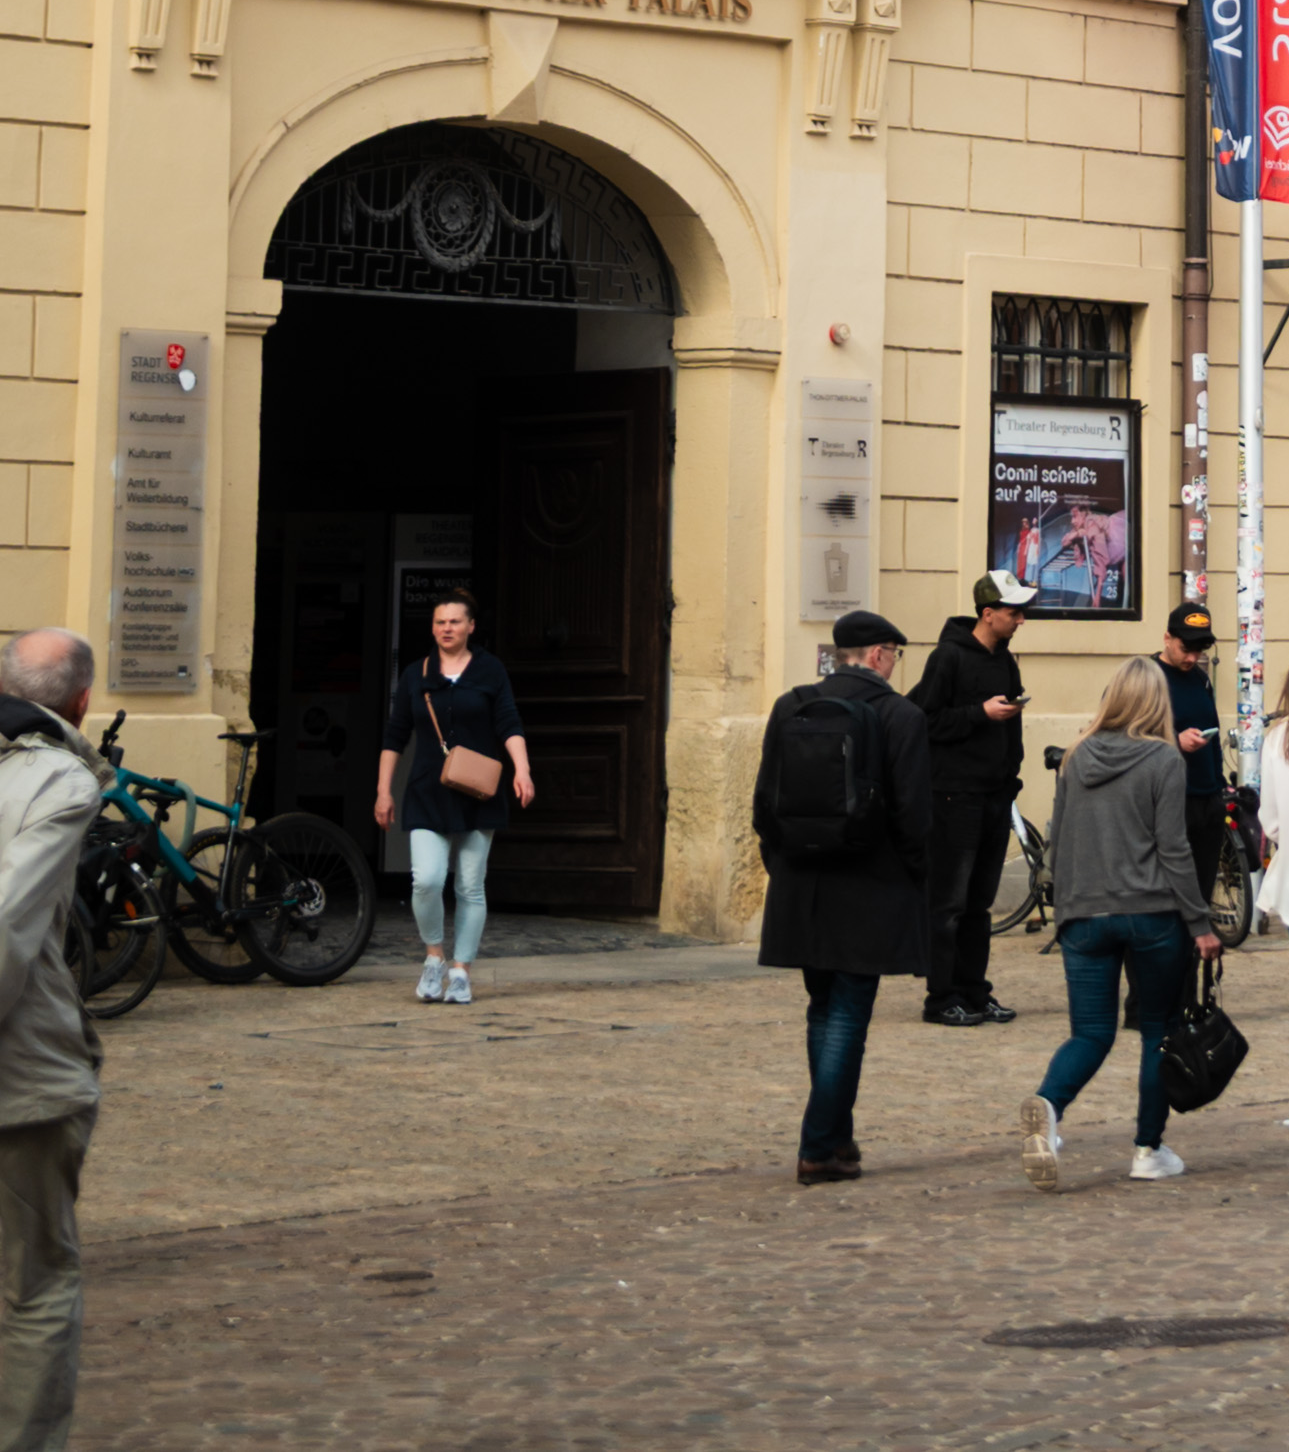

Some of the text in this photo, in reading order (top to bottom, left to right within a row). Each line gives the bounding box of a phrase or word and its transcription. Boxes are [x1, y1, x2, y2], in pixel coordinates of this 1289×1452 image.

[131, 356, 163, 368] STADT
[1006, 419, 1107, 437] Theater Regensburg
[128, 447, 172, 459] Kulturamt
[995, 463, 1097, 485] Conni scheißt
[127, 477, 160, 488] Amt für
[995, 484, 1057, 503] auf alles
[124, 566, 176, 577] hochschule
[123, 587, 173, 597] Auditorium
